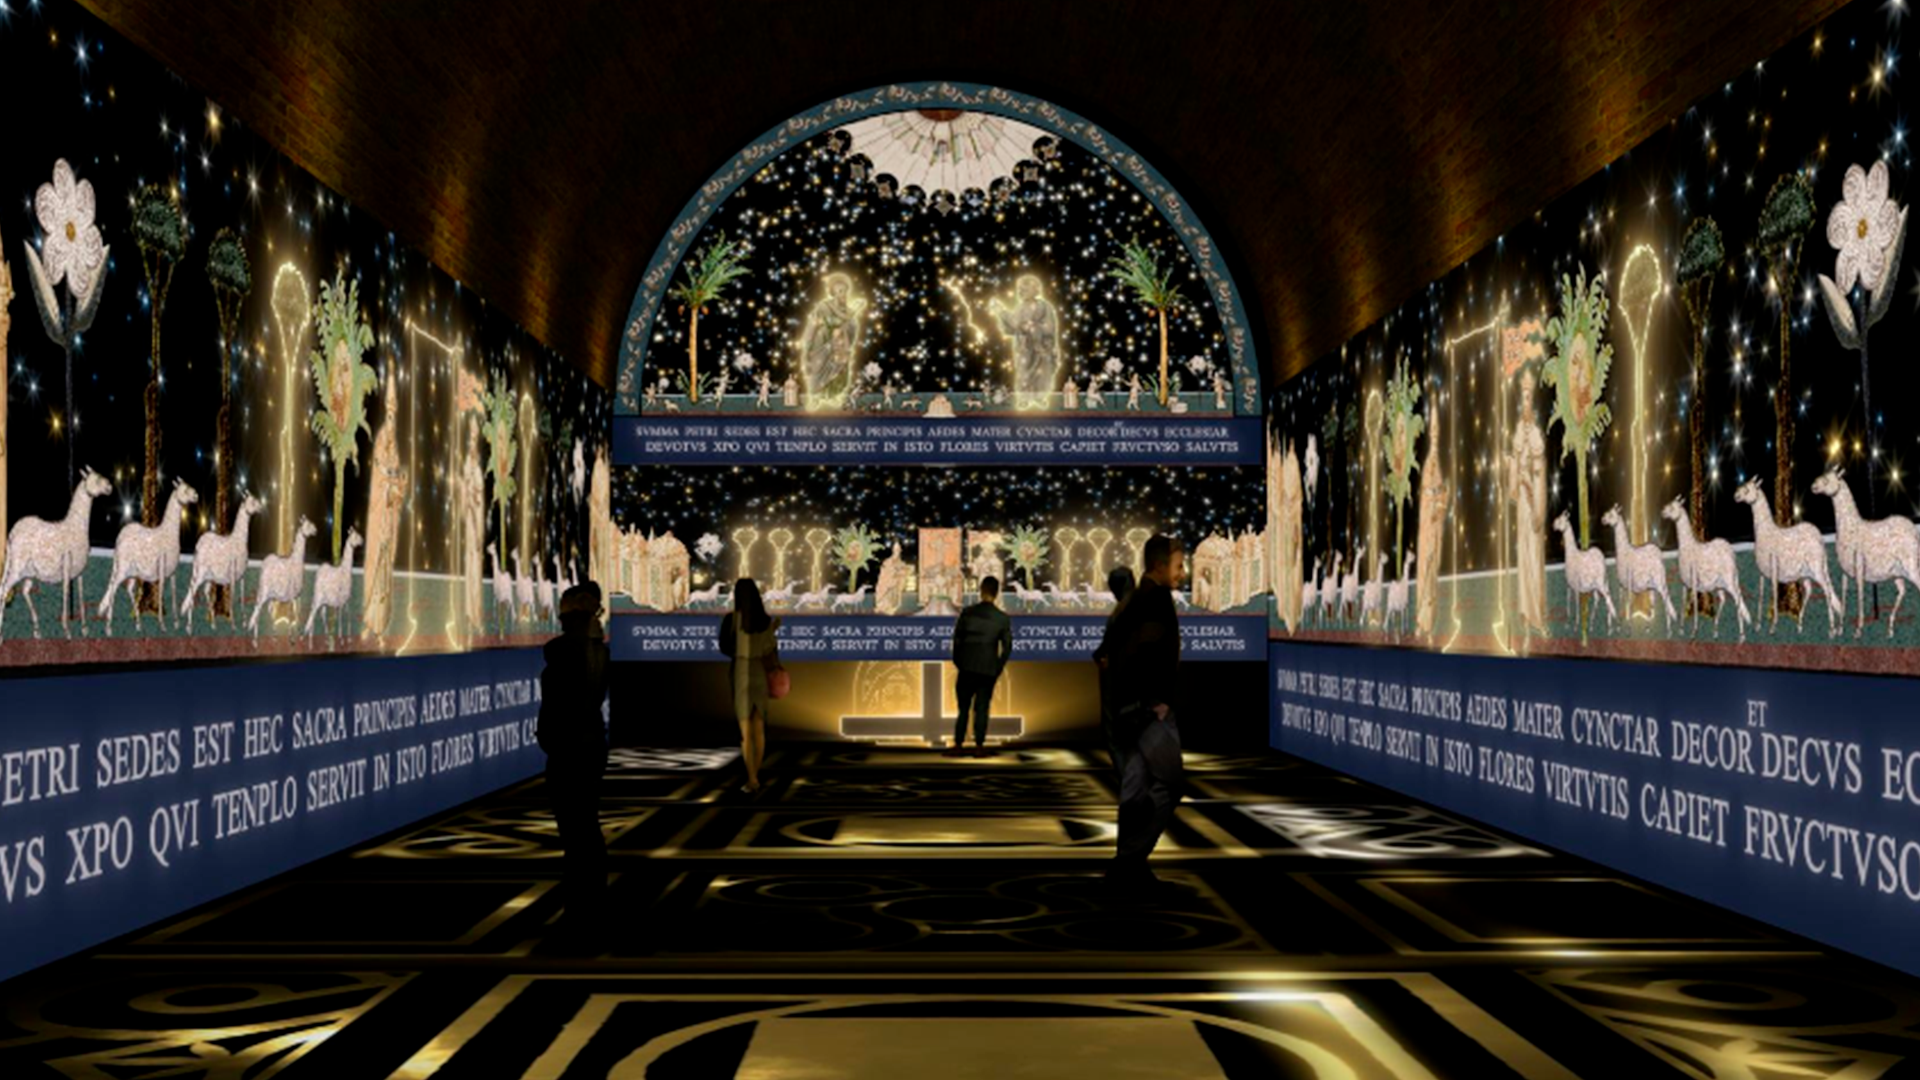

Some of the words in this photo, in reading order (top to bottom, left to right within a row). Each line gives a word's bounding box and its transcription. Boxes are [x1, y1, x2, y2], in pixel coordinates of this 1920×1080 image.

[635, 426, 679, 437] SVMMA
[684, 426, 718, 437] PETRI
[766, 426, 787, 437] EST
[822, 426, 861, 437] SACRA
[866, 426, 922, 437] PRINCIPIS
[927, 426, 965, 437] AEDES
[971, 426, 1011, 437] MATER
[1016, 426, 1072, 437] CYNCTAR
[1078, 427, 1118, 437] DECOR
[1120, 427, 1159, 438] DECVS
[645, 442, 706, 452] DEVOTVS
[713, 442, 740, 452] XPO
[746, 442, 769, 454] QVI
[775, 442, 827, 452] TENPLO
[832, 442, 877, 452] SERVIT
[884, 442, 897, 452] IN
[904, 442, 933, 452] ISTO
[940, 442, 988, 452] FLORES
[995, 442, 1054, 452] VIRTVTIS
[1060, 442, 1106, 452] CAPIET
[1186, 442, 1238, 452] SALVTIS
[643, 639, 704, 651] DEVOTVS
[832, 639, 878, 651] SERVIT
[884, 639, 899, 651] IN
[905, 639, 935, 651] ISTO
[1191, 639, 1245, 651] SALVTIS
[822, 626, 861, 637] SACRA
[1019, 626, 1076, 637] CYNCTAR
[1747, 700, 1767, 727] ET
[0, 744, 80, 806] ETRI
[97, 729, 180, 788] SEDES
[193, 722, 234, 768] EST
[243, 714, 283, 759] HEC
[292, 705, 347, 749] SACRA
[353, 695, 416, 737] PRINCIPIS
[420, 689, 456, 724] AEDES
[459, 684, 491, 716] MATER
[1378, 682, 1408, 712] SACRA
[1466, 695, 1507, 730] AEDES
[1512, 699, 1564, 740] MATER
[1571, 707, 1661, 757] CYNCTAR
[1671, 721, 1755, 775] DECOR
[1761, 732, 1862, 793] DECVS
[65, 816, 133, 884] XPO
[150, 799, 200, 867] QVI
[212, 776, 298, 839] TENPLO
[306, 759, 367, 811] SERVIT
[373, 753, 390, 791] IN
[396, 744, 426, 785] ISTO
[431, 733, 474, 774] FLORES
[1386, 725, 1422, 762] SERVIT
[1426, 734, 1439, 767] IN
[1444, 739, 1473, 776] ISTO
[1478, 746, 1535, 793] FLORES
[1542, 760, 1629, 820] VIRTVTIS
[1640, 783, 1729, 847] CAPIET
[1744, 805, 1920, 901] FRVCTVSO
